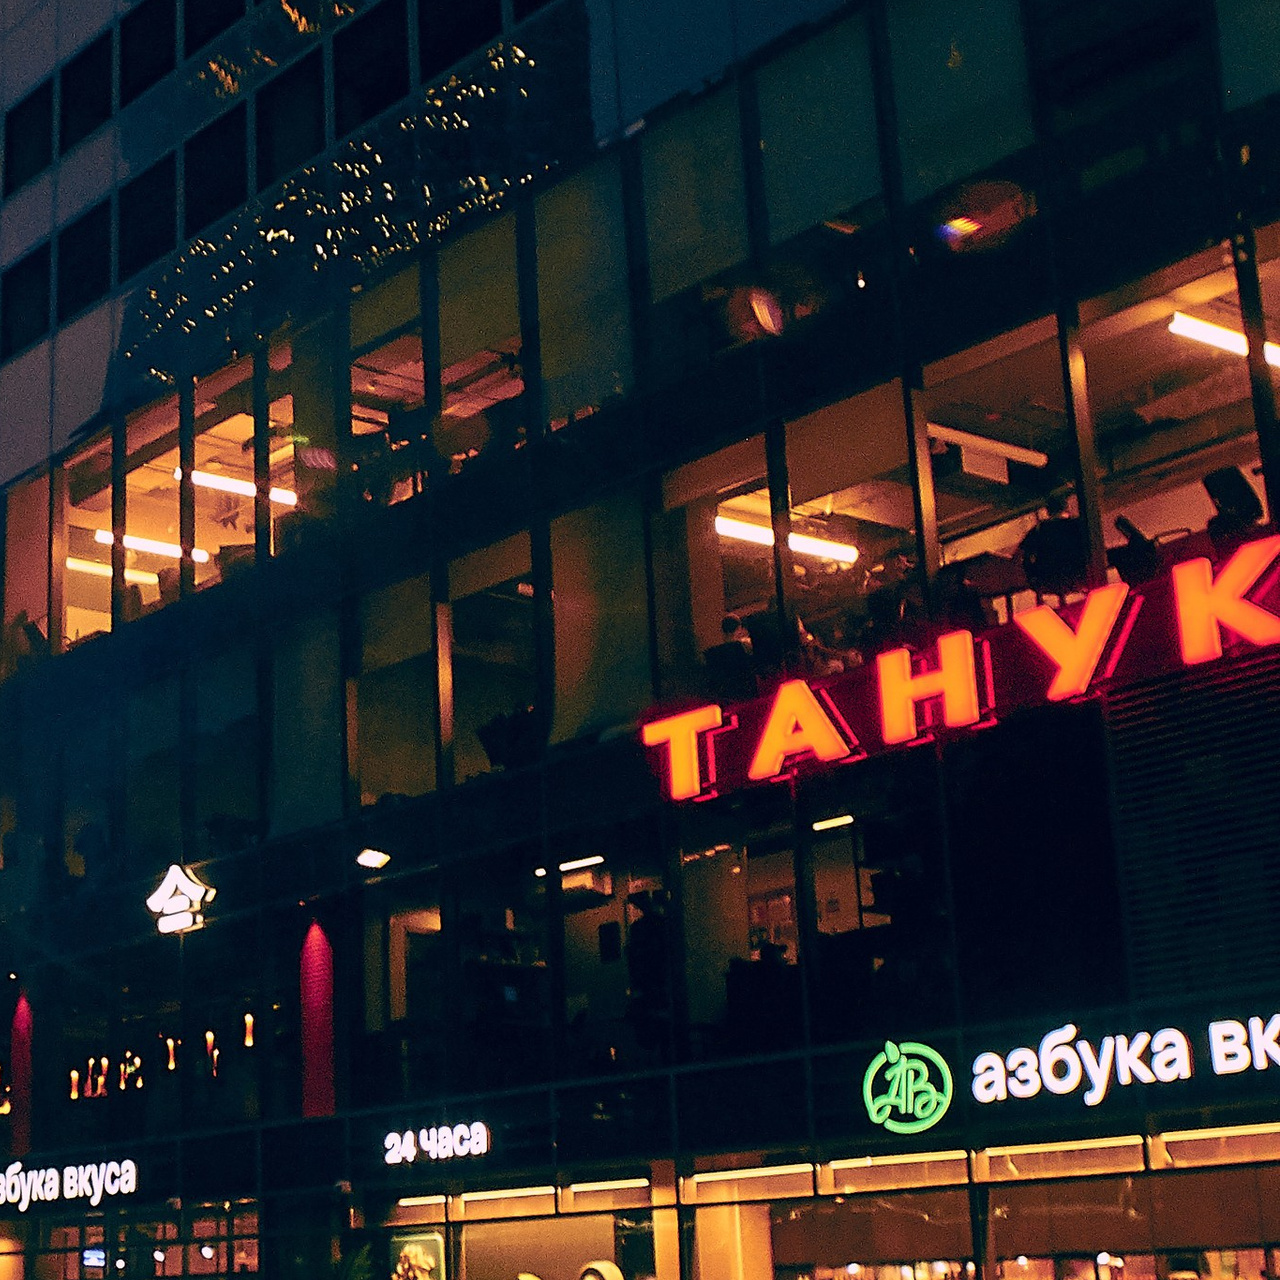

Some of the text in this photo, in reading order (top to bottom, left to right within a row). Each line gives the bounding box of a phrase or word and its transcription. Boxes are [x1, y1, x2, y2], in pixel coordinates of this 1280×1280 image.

[642, 533, 1280, 802] ТАНУК
[971, 1023, 1192, 1106] азбука
[384, 1121, 489, 1164] 24 часа
[63, 1159, 136, 1207] вкуса
